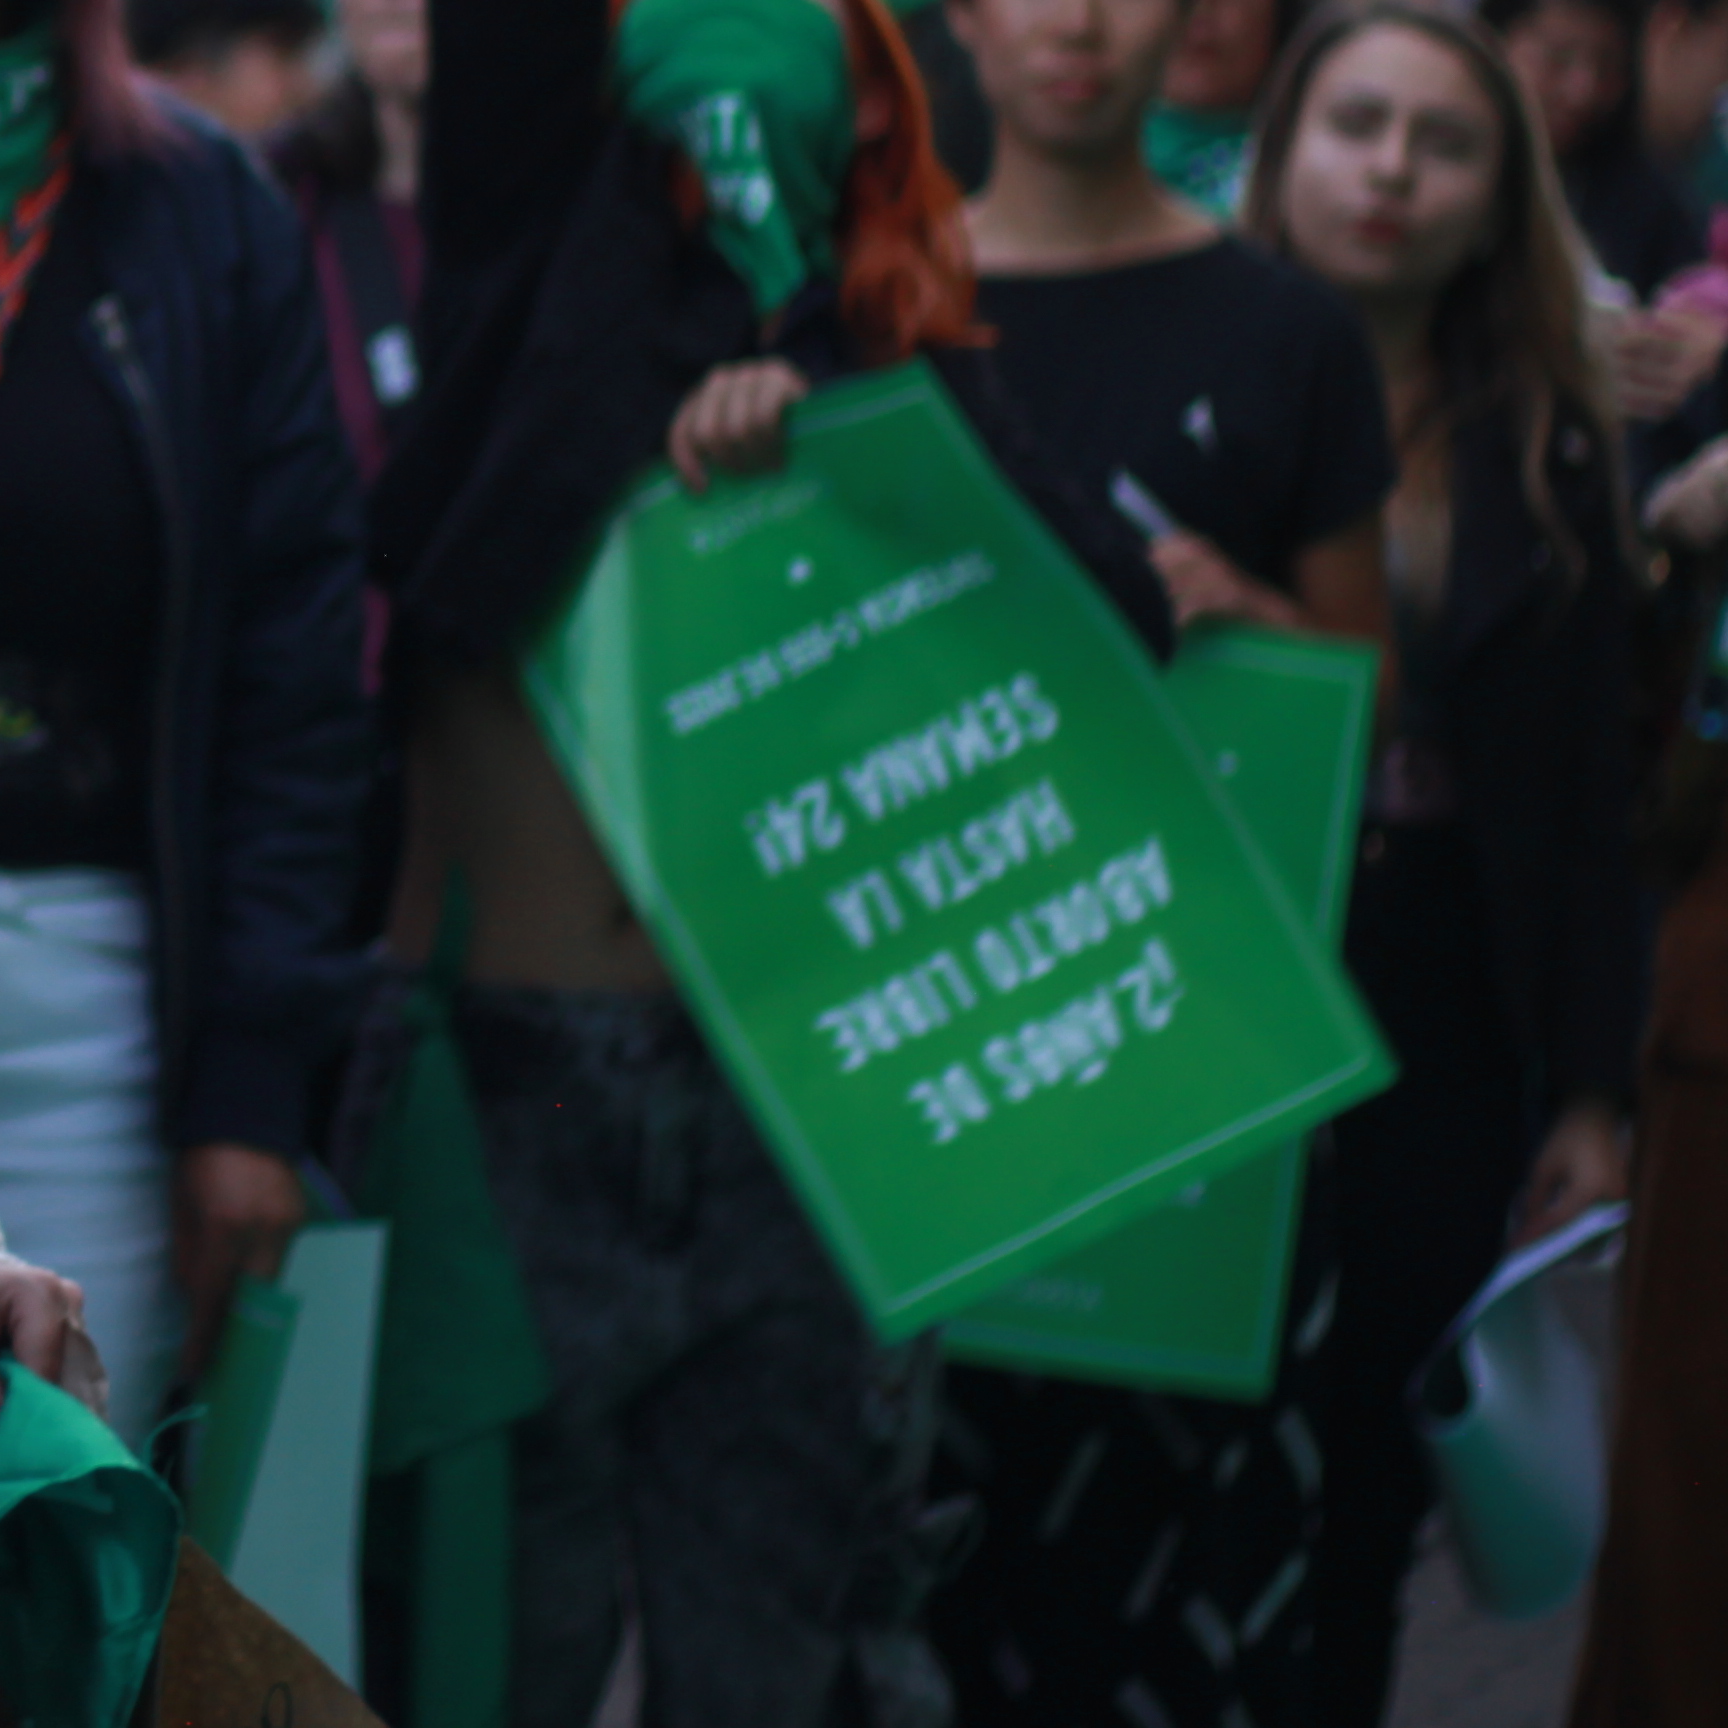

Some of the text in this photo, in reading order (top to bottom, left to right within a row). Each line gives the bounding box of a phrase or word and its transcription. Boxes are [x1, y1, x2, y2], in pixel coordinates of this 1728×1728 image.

[742, 670, 1062, 880] SEMANA 24!
[825, 775, 1078, 952] HASTA LA
[811, 834, 1174, 1074] ABORTO LIBRE
[904, 1059, 994, 1147] DE
[978, 985, 1124, 1106] AÑOS
